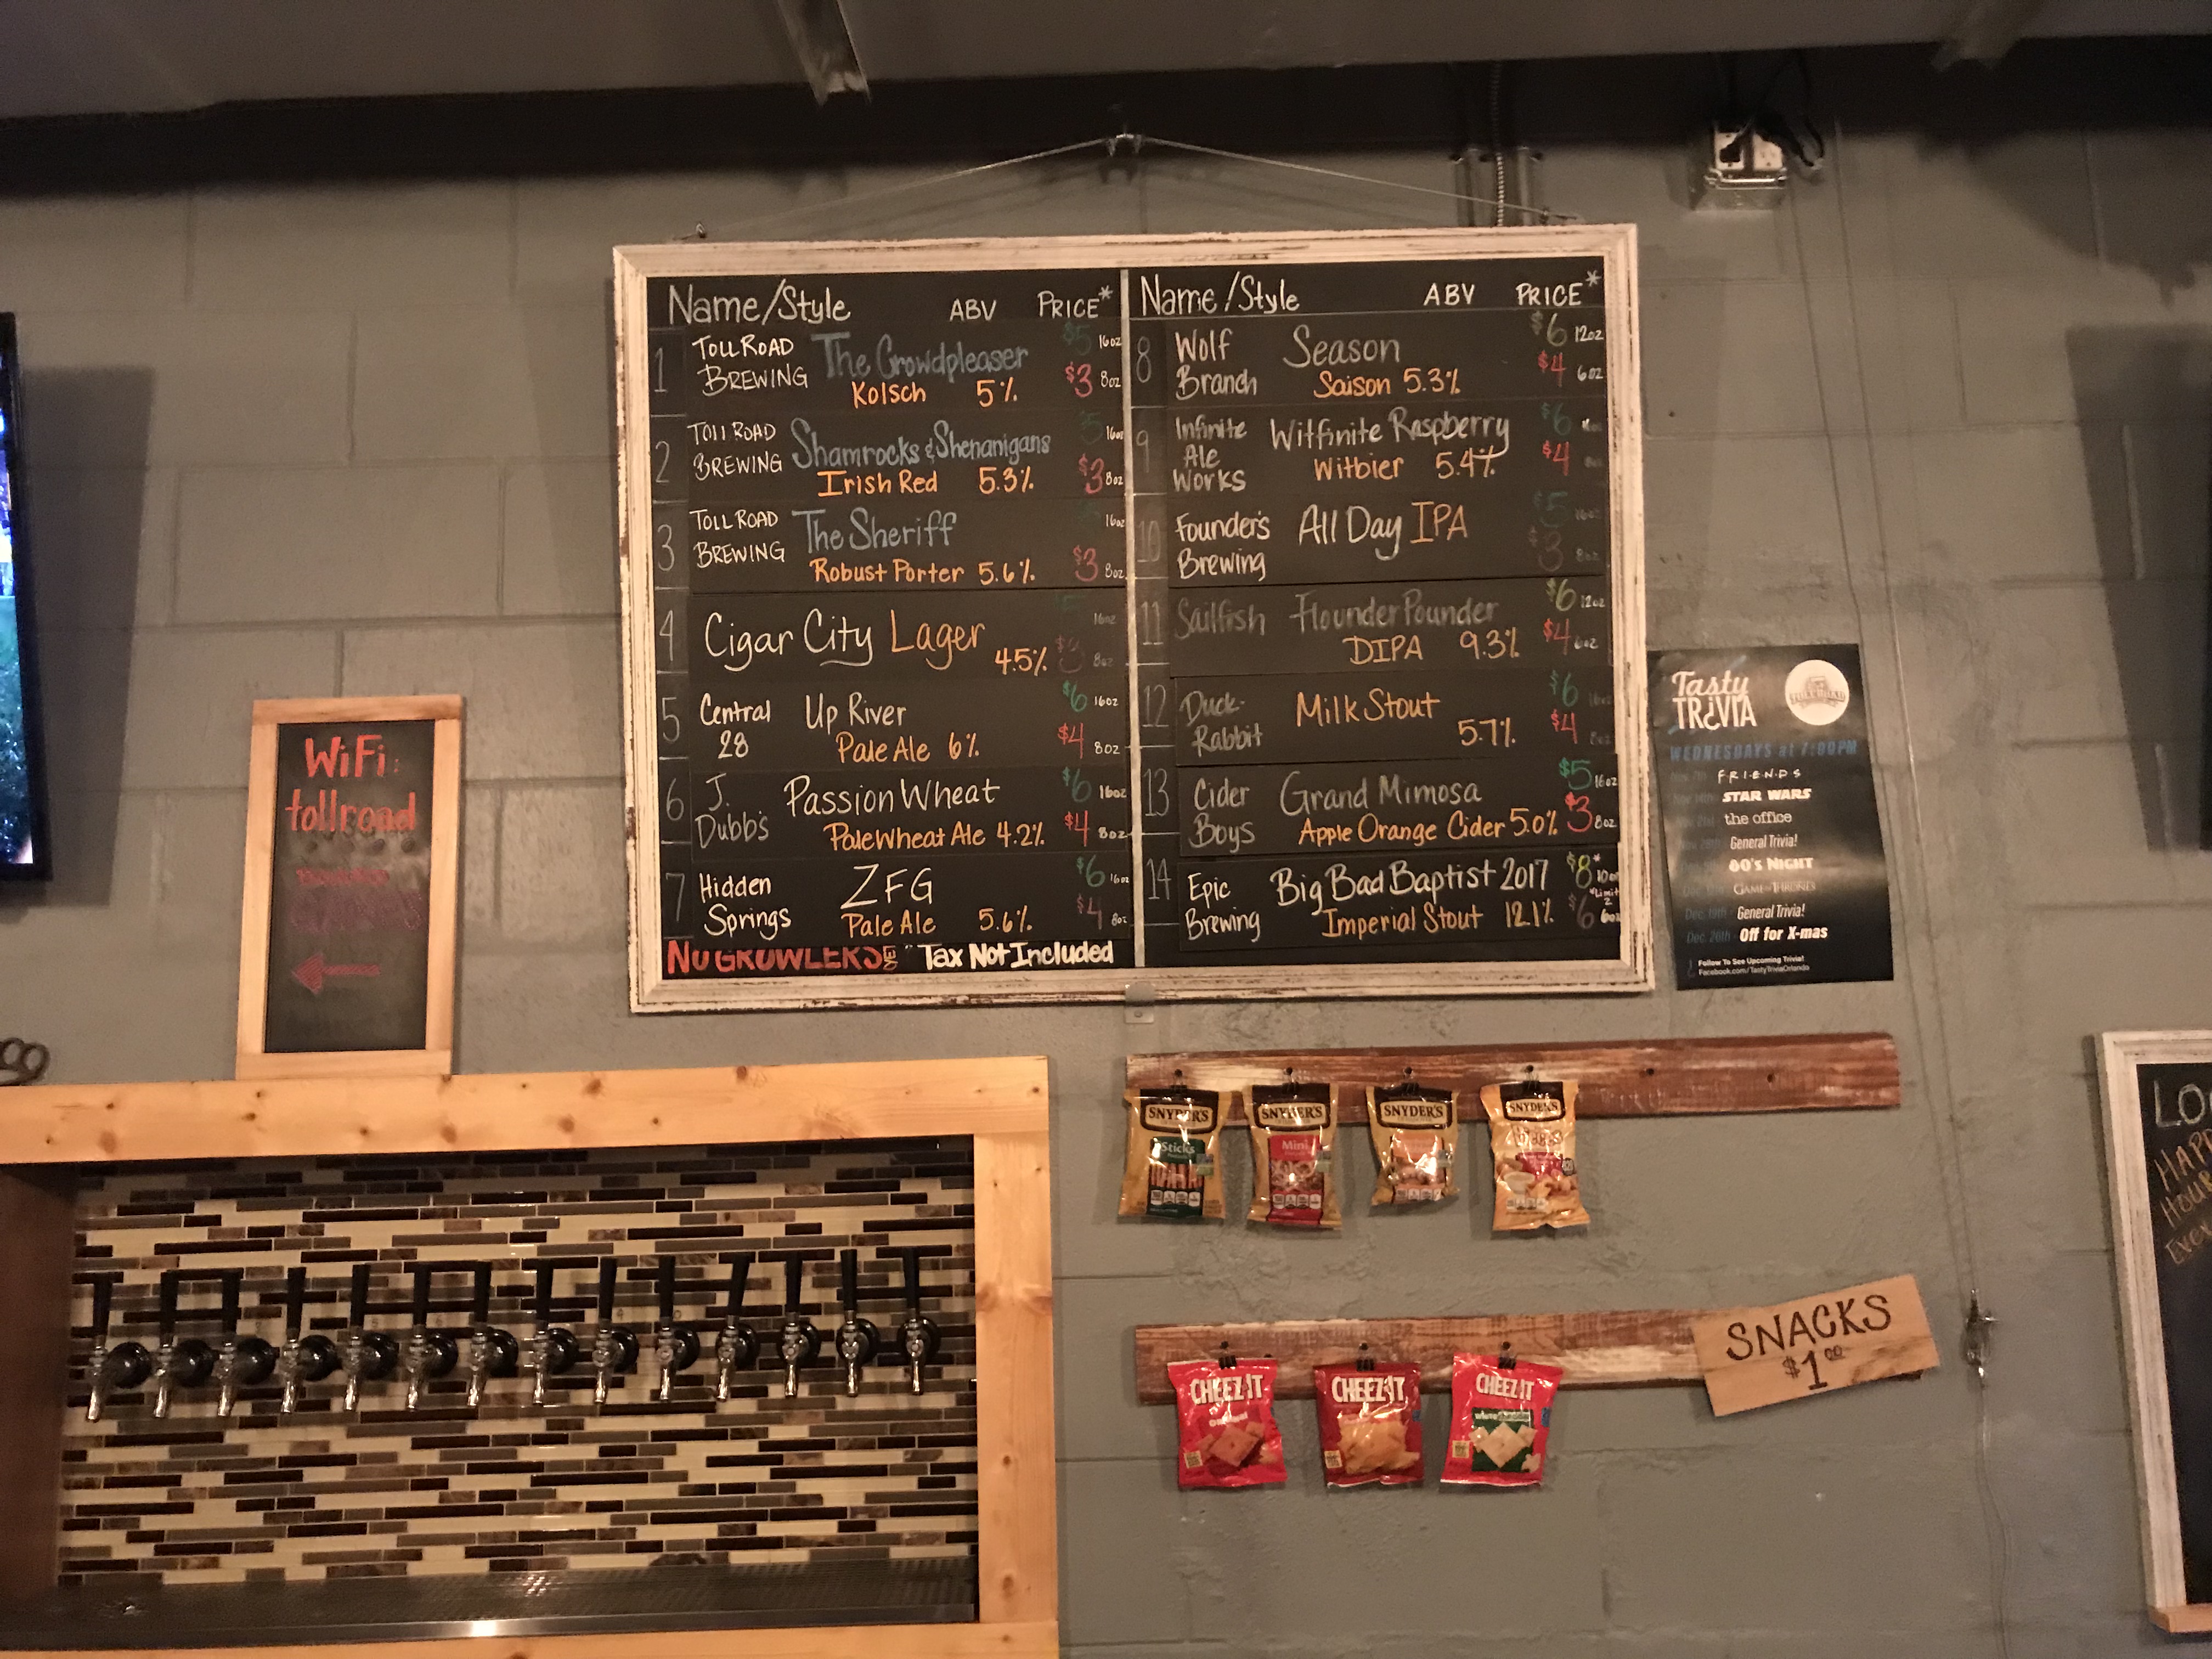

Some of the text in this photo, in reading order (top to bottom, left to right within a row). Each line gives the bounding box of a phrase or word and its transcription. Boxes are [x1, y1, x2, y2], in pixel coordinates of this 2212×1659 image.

[669, 279, 850, 325] Name/Style
[950, 298, 997, 322] ABV
[1423, 283, 1475, 306] ABV
[741, 334, 794, 357] ROAD
[1175, 328, 1233, 363] Wolf
[1283, 324, 1400, 368] Season
[1531, 311, 1604, 346] $6 12oz
[810, 332, 1028, 383] The Crowdpleaser
[1136, 336, 1152, 383] 8
[1538, 349, 1567, 387] $4
[697, 364, 808, 396] BREWING
[852, 376, 1018, 409] Kolsch 5%
[1065, 362, 1122, 398] $3 8oz
[1176, 364, 1257, 400] Branch
[1313, 368, 1462, 398] Saison 5.3%
[732, 421, 776, 440] ROAD
[791, 417, 921, 469] Shamrocks
[934, 420, 1051, 465] Shenanigans
[1176, 414, 1248, 439] Infinite
[1387, 406, 1509, 459] Raspberry
[655, 441, 669, 483] 2
[693, 452, 783, 481] BREWING
[1079, 453, 1105, 494] $3
[1183, 443, 1221, 469] Ale
[1313, 452, 1403, 481] Witbier
[1542, 440, 1569, 476] $4
[817, 465, 1034, 496] Irish Red 5.3%
[689, 509, 779, 531] TOLL ROAD
[791, 506, 957, 554] The Sheriff
[1299, 501, 1468, 561] All Day IPA
[657, 524, 675, 571] 3
[693, 540, 785, 568] BREWING
[1073, 544, 1098, 582] $3
[1177, 547, 1266, 582] Brewing
[809, 557, 1036, 585] Robust Porter 5.6%
[1402, 588, 1500, 627] Pounder
[1545, 578, 1577, 612] $6
[659, 610, 674, 661] 4
[705, 608, 986, 672] Cigar City Lager
[1342, 628, 1520, 663] DIPA 9.3%
[1543, 618, 1572, 656] $4
[1094, 696, 1119, 707] 16oz
[1672, 670, 1750, 702] Tasty
[662, 697, 680, 743] 5
[700, 692, 771, 726] Central
[806, 691, 906, 735] Up River
[1143, 684, 1169, 727] 12
[1296, 687, 1440, 727] Milk Stout
[1057, 722, 1120, 759] $4 8oz
[1191, 723, 1263, 758] Rabbit
[1458, 717, 1516, 747] 5.7%
[1551, 708, 1578, 744] $4
[718, 730, 749, 759] 28
[835, 731, 979, 763] Pale Ale 6%
[1559, 757, 1618, 790] $5 16oz
[666, 778, 685, 821] 6
[706, 773, 730, 811] J.
[783, 775, 1000, 817] Passion Wheat
[1142, 768, 1169, 816] 13
[1194, 776, 1250, 811] Cider
[1280, 770, 1482, 816] Grand Mimosa
[1722, 790, 1762, 803] STAR
[1767, 788, 1812, 800] WARS
[285, 789, 415, 832] tollroad
[1064, 810, 1090, 847] $4
[1299, 808, 1558, 848] Apple Orange Cider 5.0%
[1724, 812, 1749, 825] the
[1753, 811, 1792, 824] office
[695, 810, 768, 849] Dubb's
[950, 821, 1045, 848] Ale 4.2%
[1189, 812, 1255, 853] Boys
[1730, 836, 1767, 849] General
[1769, 834, 1798, 848] Trivia!
[699, 873, 771, 904] Hidden
[1076, 855, 1105, 887] $6
[1146, 858, 1172, 900] 14
[1269, 857, 1549, 916] Big Bad Baptist 2017
[665, 872, 685, 922] 7
[1187, 872, 1231, 909] Epic
[704, 904, 792, 940] Springs
[840, 905, 1033, 938] Pale Ale 5.6%
[1322, 901, 1483, 940] Imperial Stout
[1737, 905, 1774, 920] General
[1776, 904, 1806, 918] Trivia!
[1740, 927, 1760, 943] Off
[1764, 927, 1783, 941] for
[1787, 926, 1829, 939] X-mas
[917, 940, 1114, 970] Tax Not Included
[1384, 1104, 1444, 1119] SNYDER'S
[2153, 1080, 2212, 1128] LO
[1161, 1141, 1195, 1154] Sticks
[1282, 1139, 1309, 1151] Mini
[1726, 1295, 1892, 1361] SNACKS
